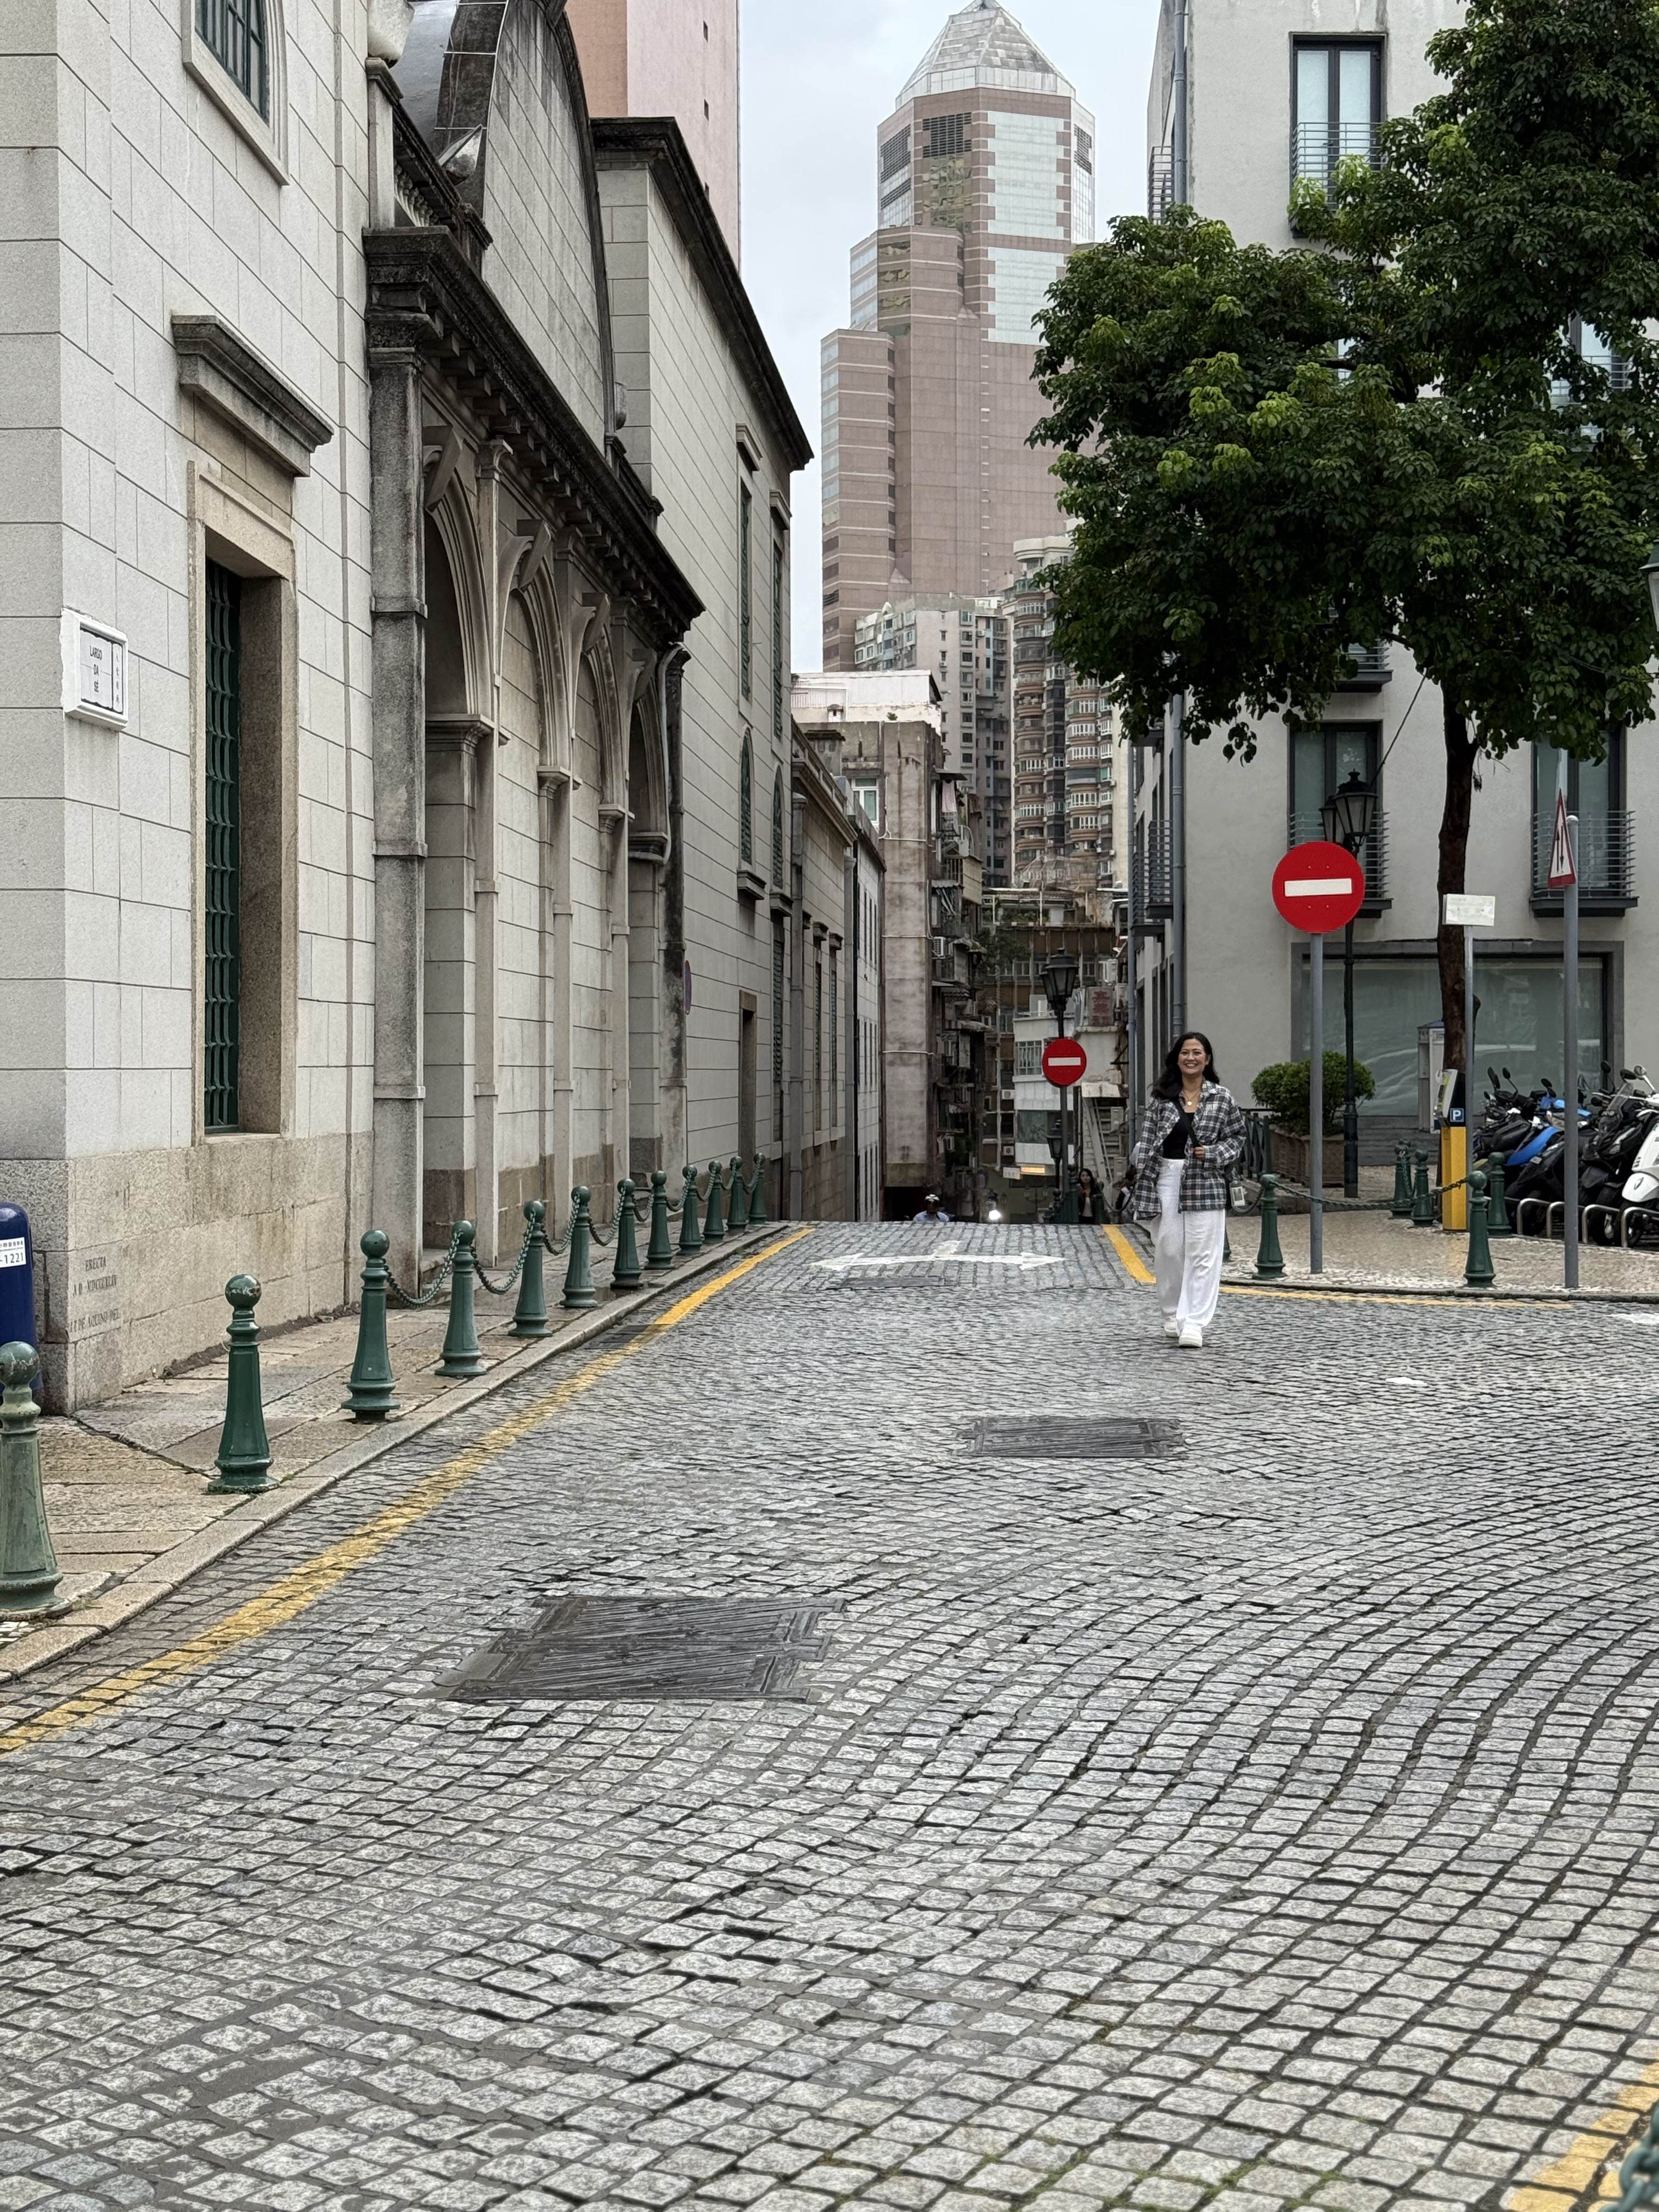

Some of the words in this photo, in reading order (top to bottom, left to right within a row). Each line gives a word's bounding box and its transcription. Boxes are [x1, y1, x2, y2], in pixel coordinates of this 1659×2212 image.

[89, 646, 103, 661] LARGO
[93, 664, 99, 676] DA
[85, 1256, 106, 1271] ERECTA
